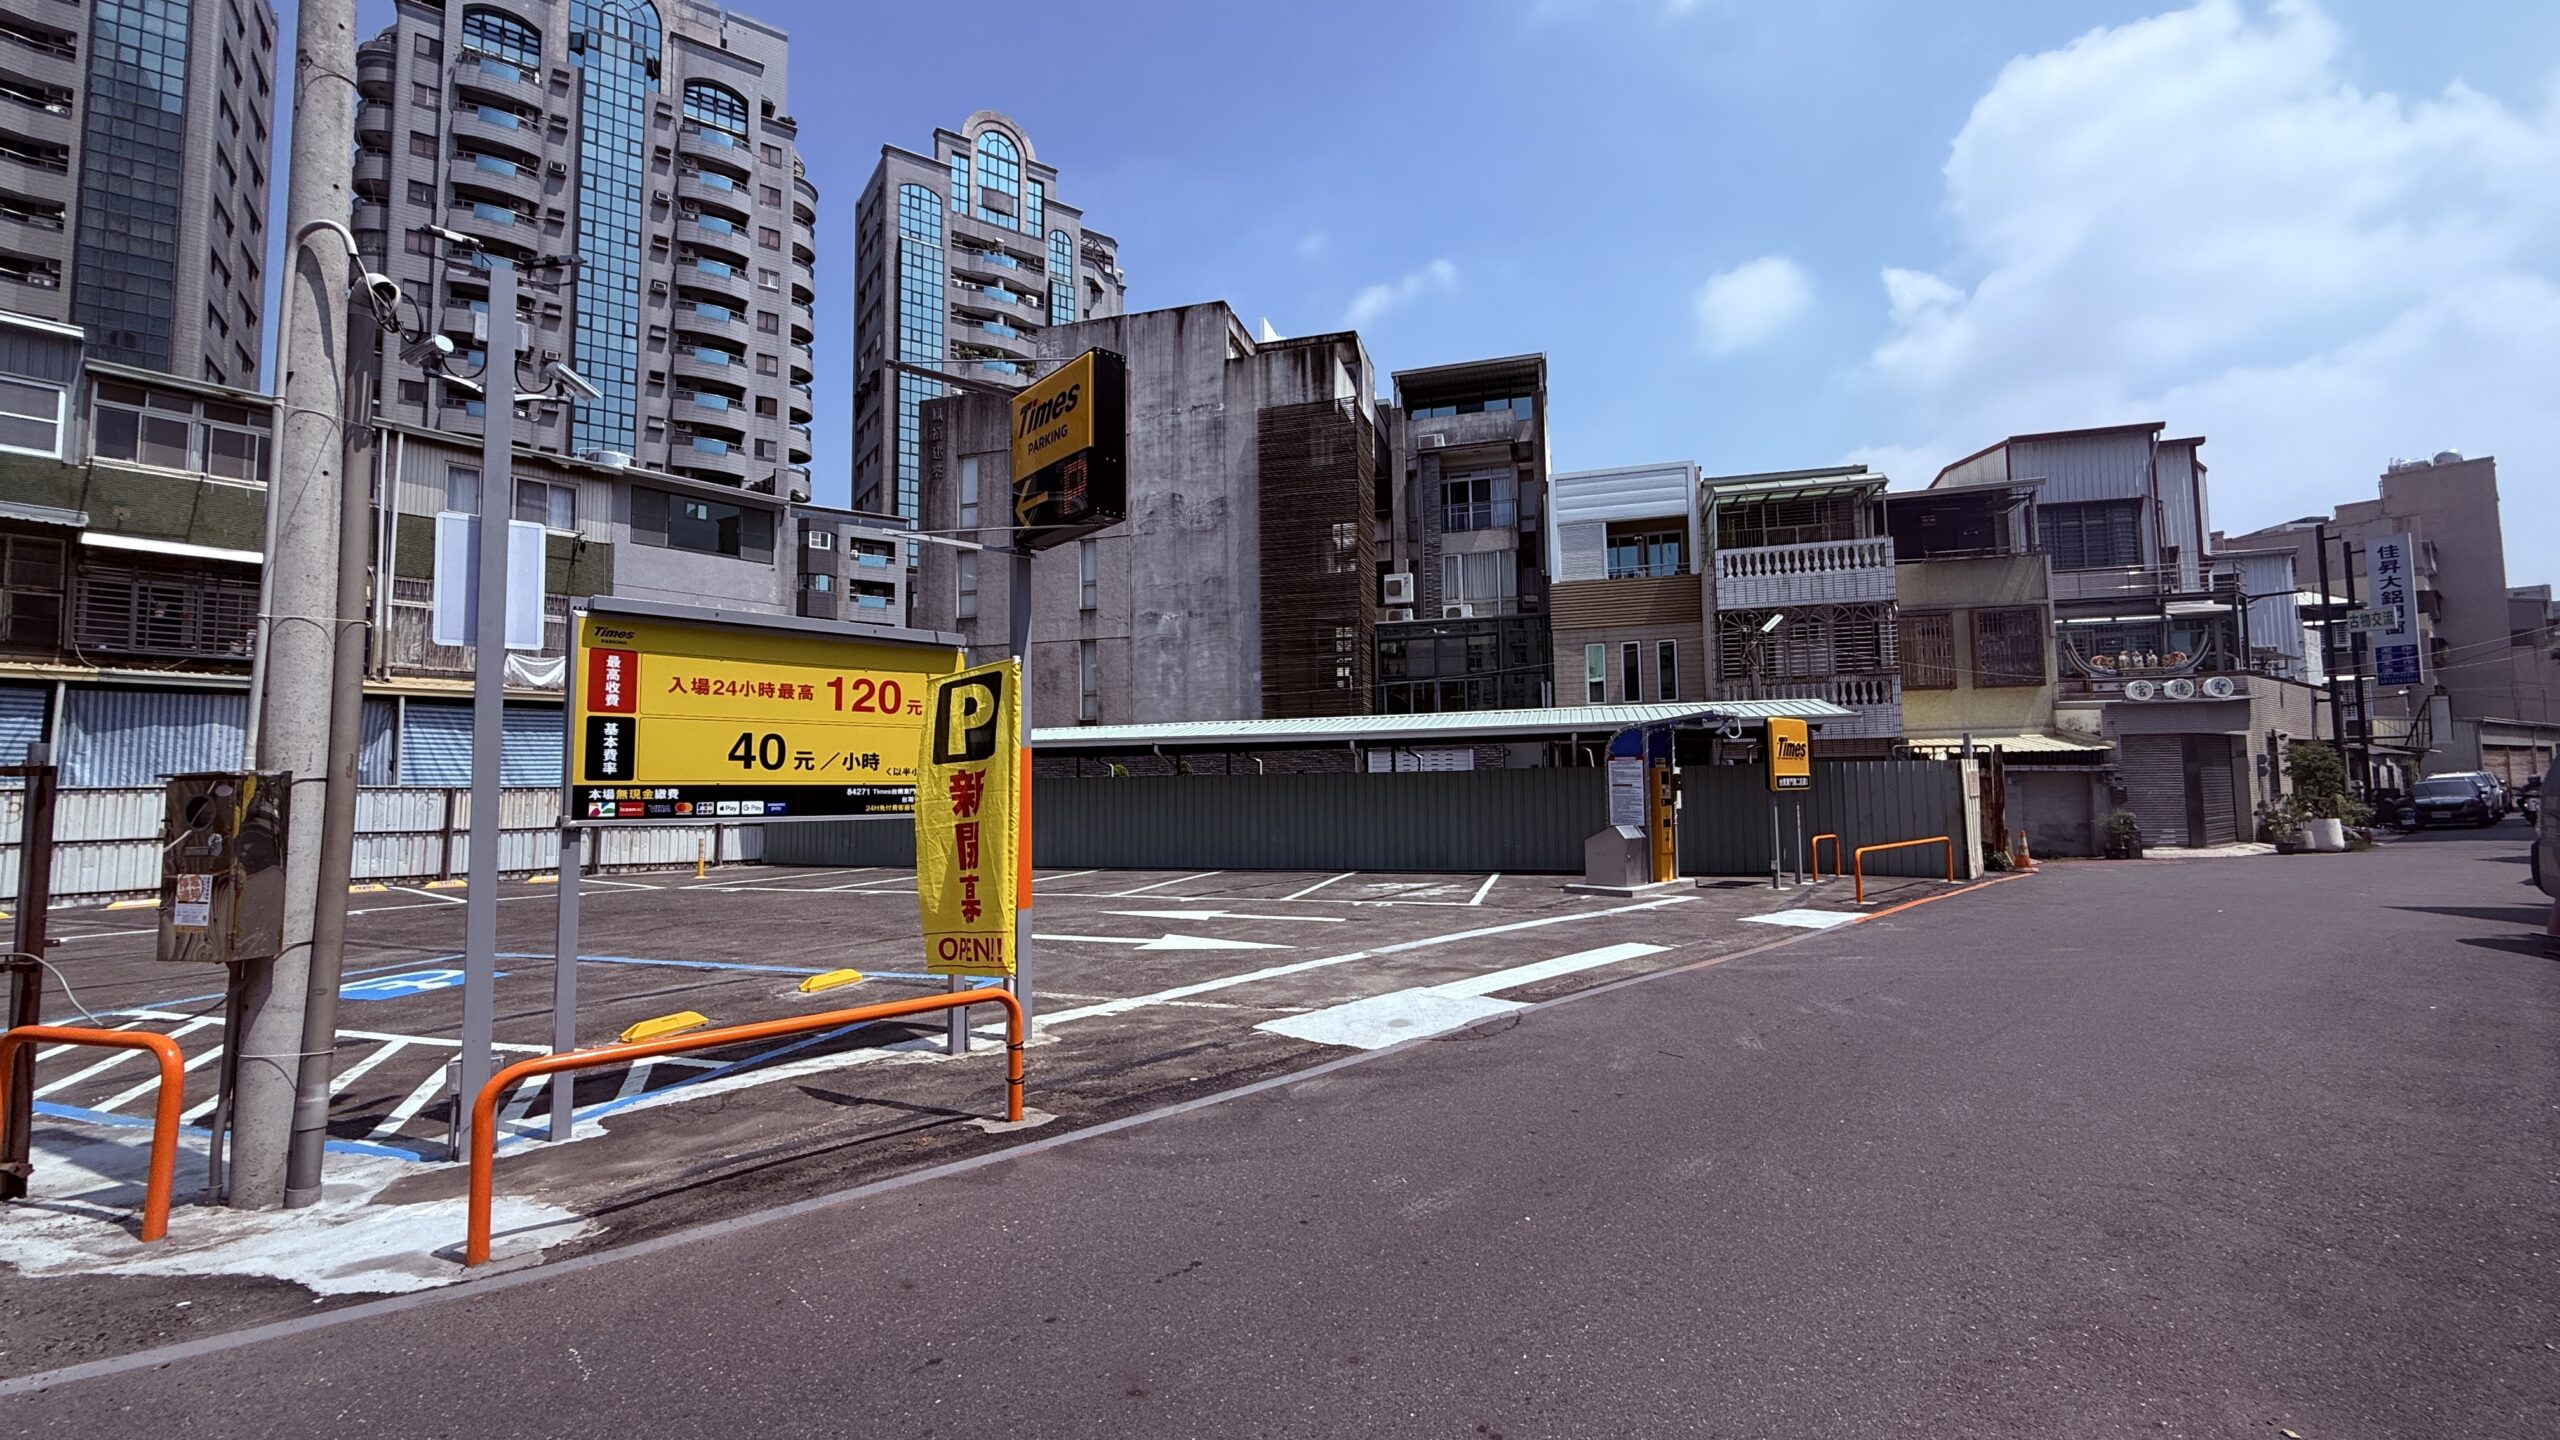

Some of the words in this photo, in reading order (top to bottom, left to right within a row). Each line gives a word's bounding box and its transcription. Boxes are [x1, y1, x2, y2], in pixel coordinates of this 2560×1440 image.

[1018, 383, 1080, 440] Times
[1028, 424, 1068, 455] PARKING
[594, 626, 635, 640] Times
[605, 654, 621, 707] 最高收費
[668, 676, 814, 702] 入場24小時最高
[602, 722, 619, 775] 基本費率
[1778, 736, 1806, 758] Times
[588, 789, 680, 800] 本場無現金繳費
[847, 788, 870, 796] 84271
